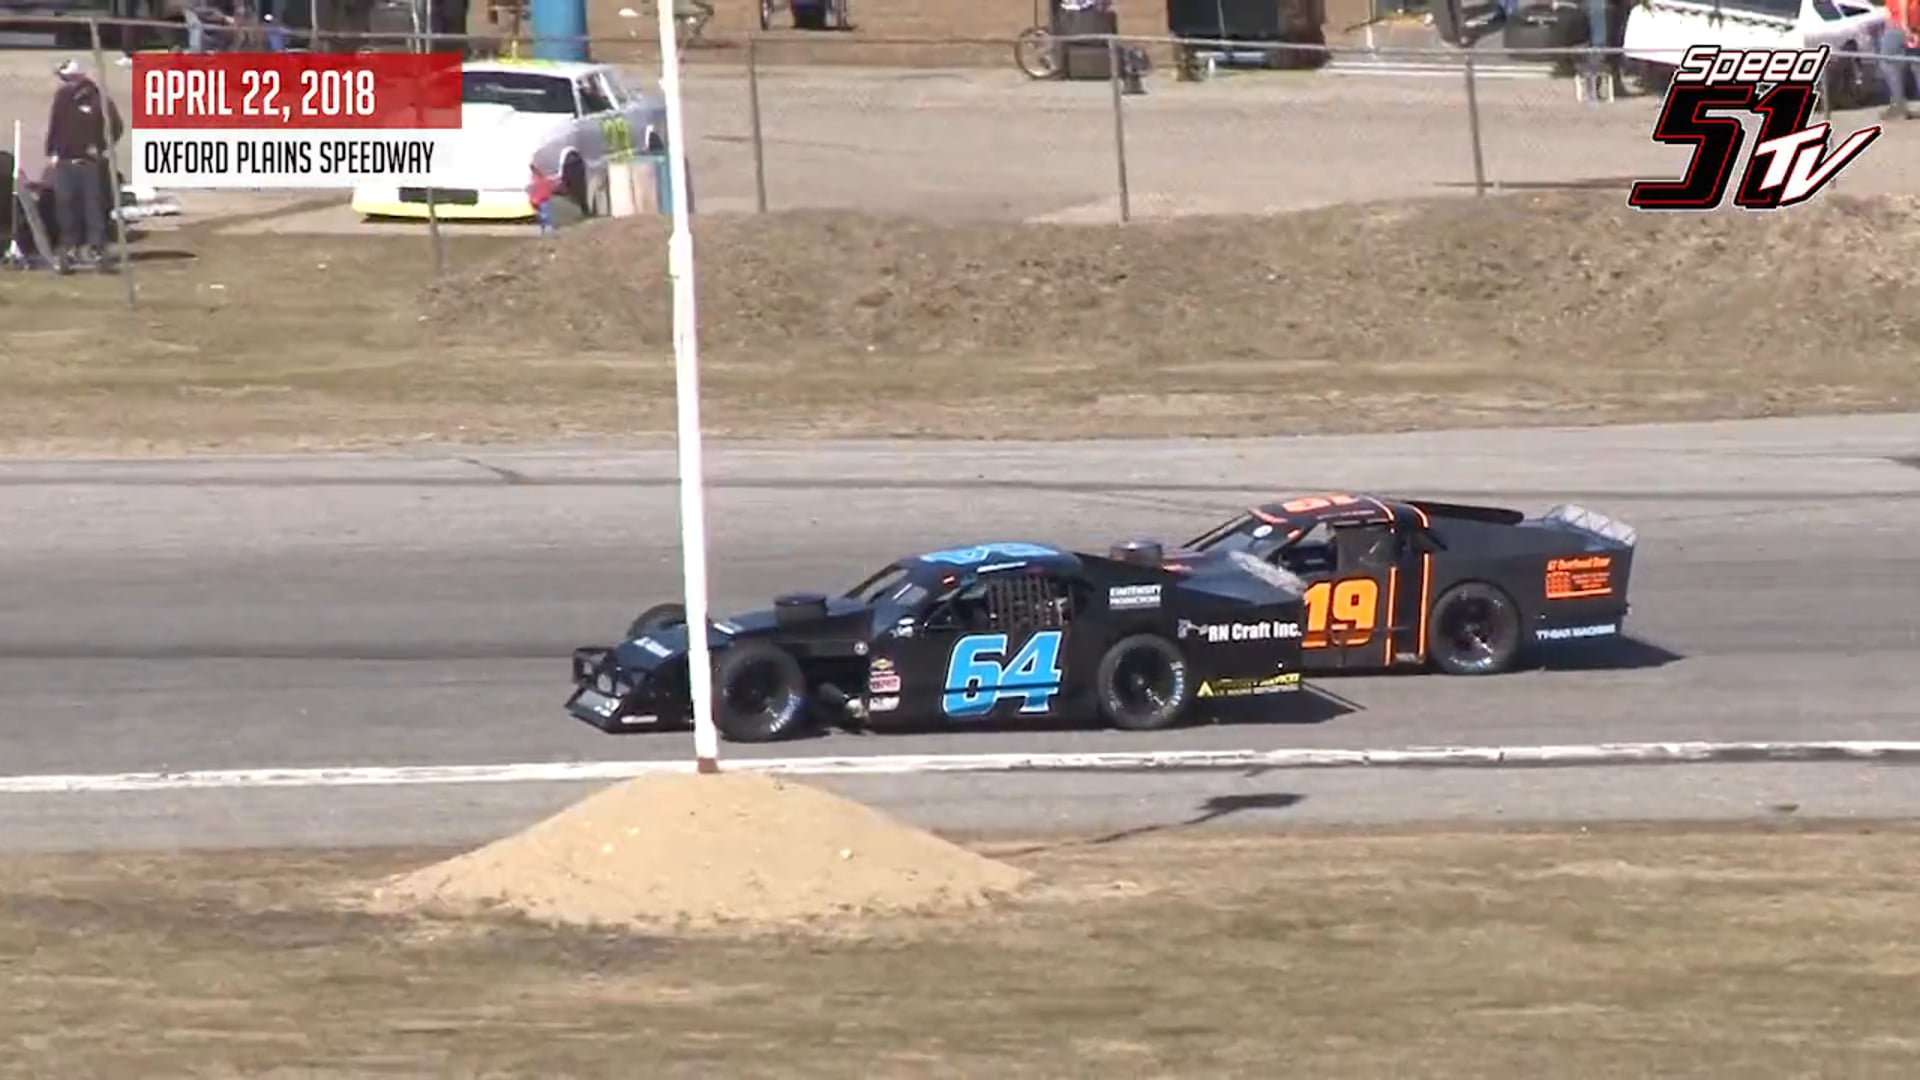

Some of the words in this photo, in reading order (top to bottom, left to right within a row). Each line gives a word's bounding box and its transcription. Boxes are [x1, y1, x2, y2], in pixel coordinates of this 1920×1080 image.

[1208, 624, 1229, 642] RN
[1231, 621, 1271, 641] Craft
[1273, 620, 1302, 639] Inc.
[1301, 578, 1379, 648] 19
[942, 631, 1062, 717] 64
